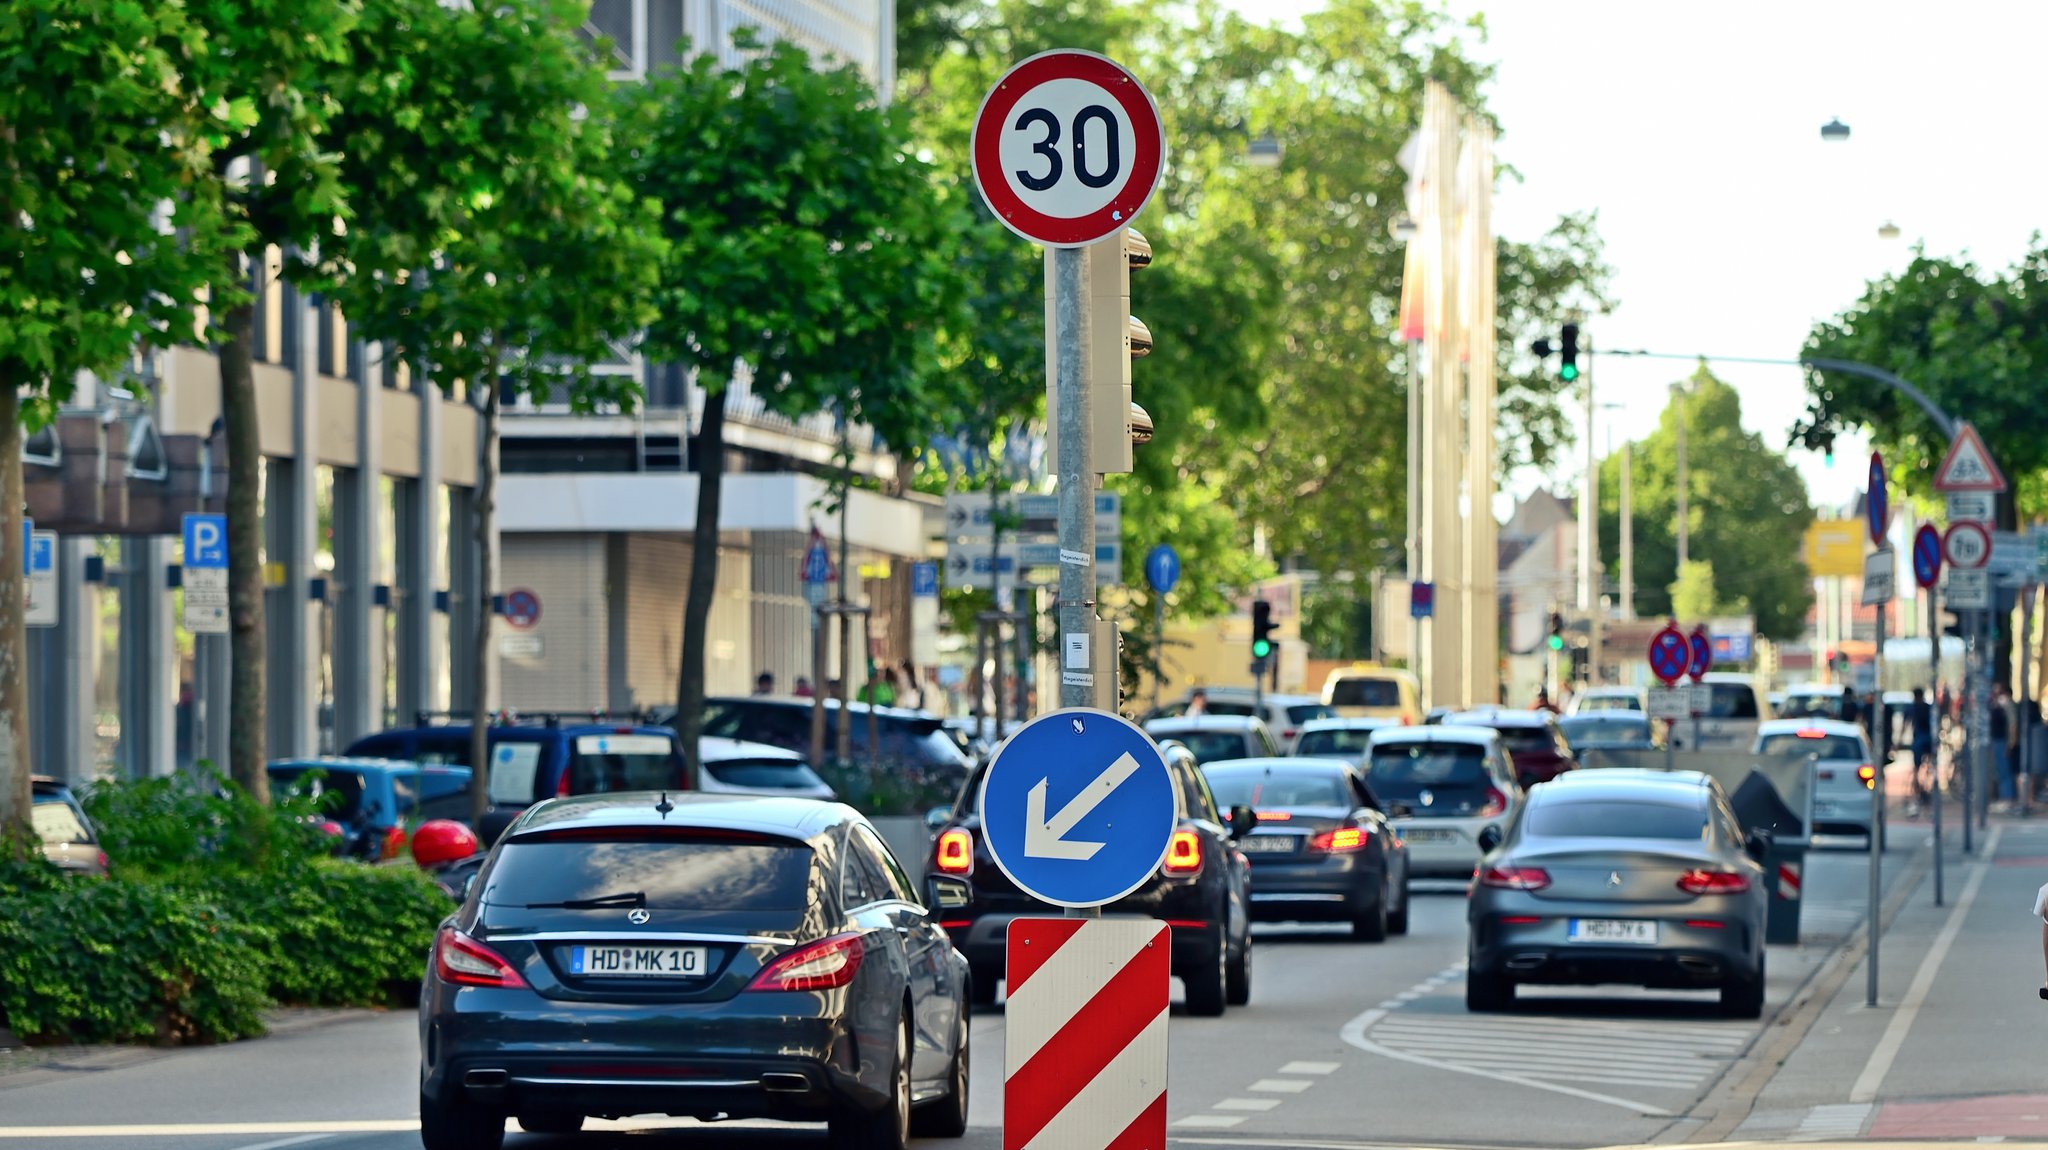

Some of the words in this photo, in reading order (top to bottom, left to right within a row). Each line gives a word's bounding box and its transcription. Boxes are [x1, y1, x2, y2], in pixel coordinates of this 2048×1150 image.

[1015, 105, 1120, 192] 30
[194, 522, 219, 562] P
[591, 949, 620, 970] HD
[635, 950, 664, 971] MK
[669, 951, 696, 971] 10
